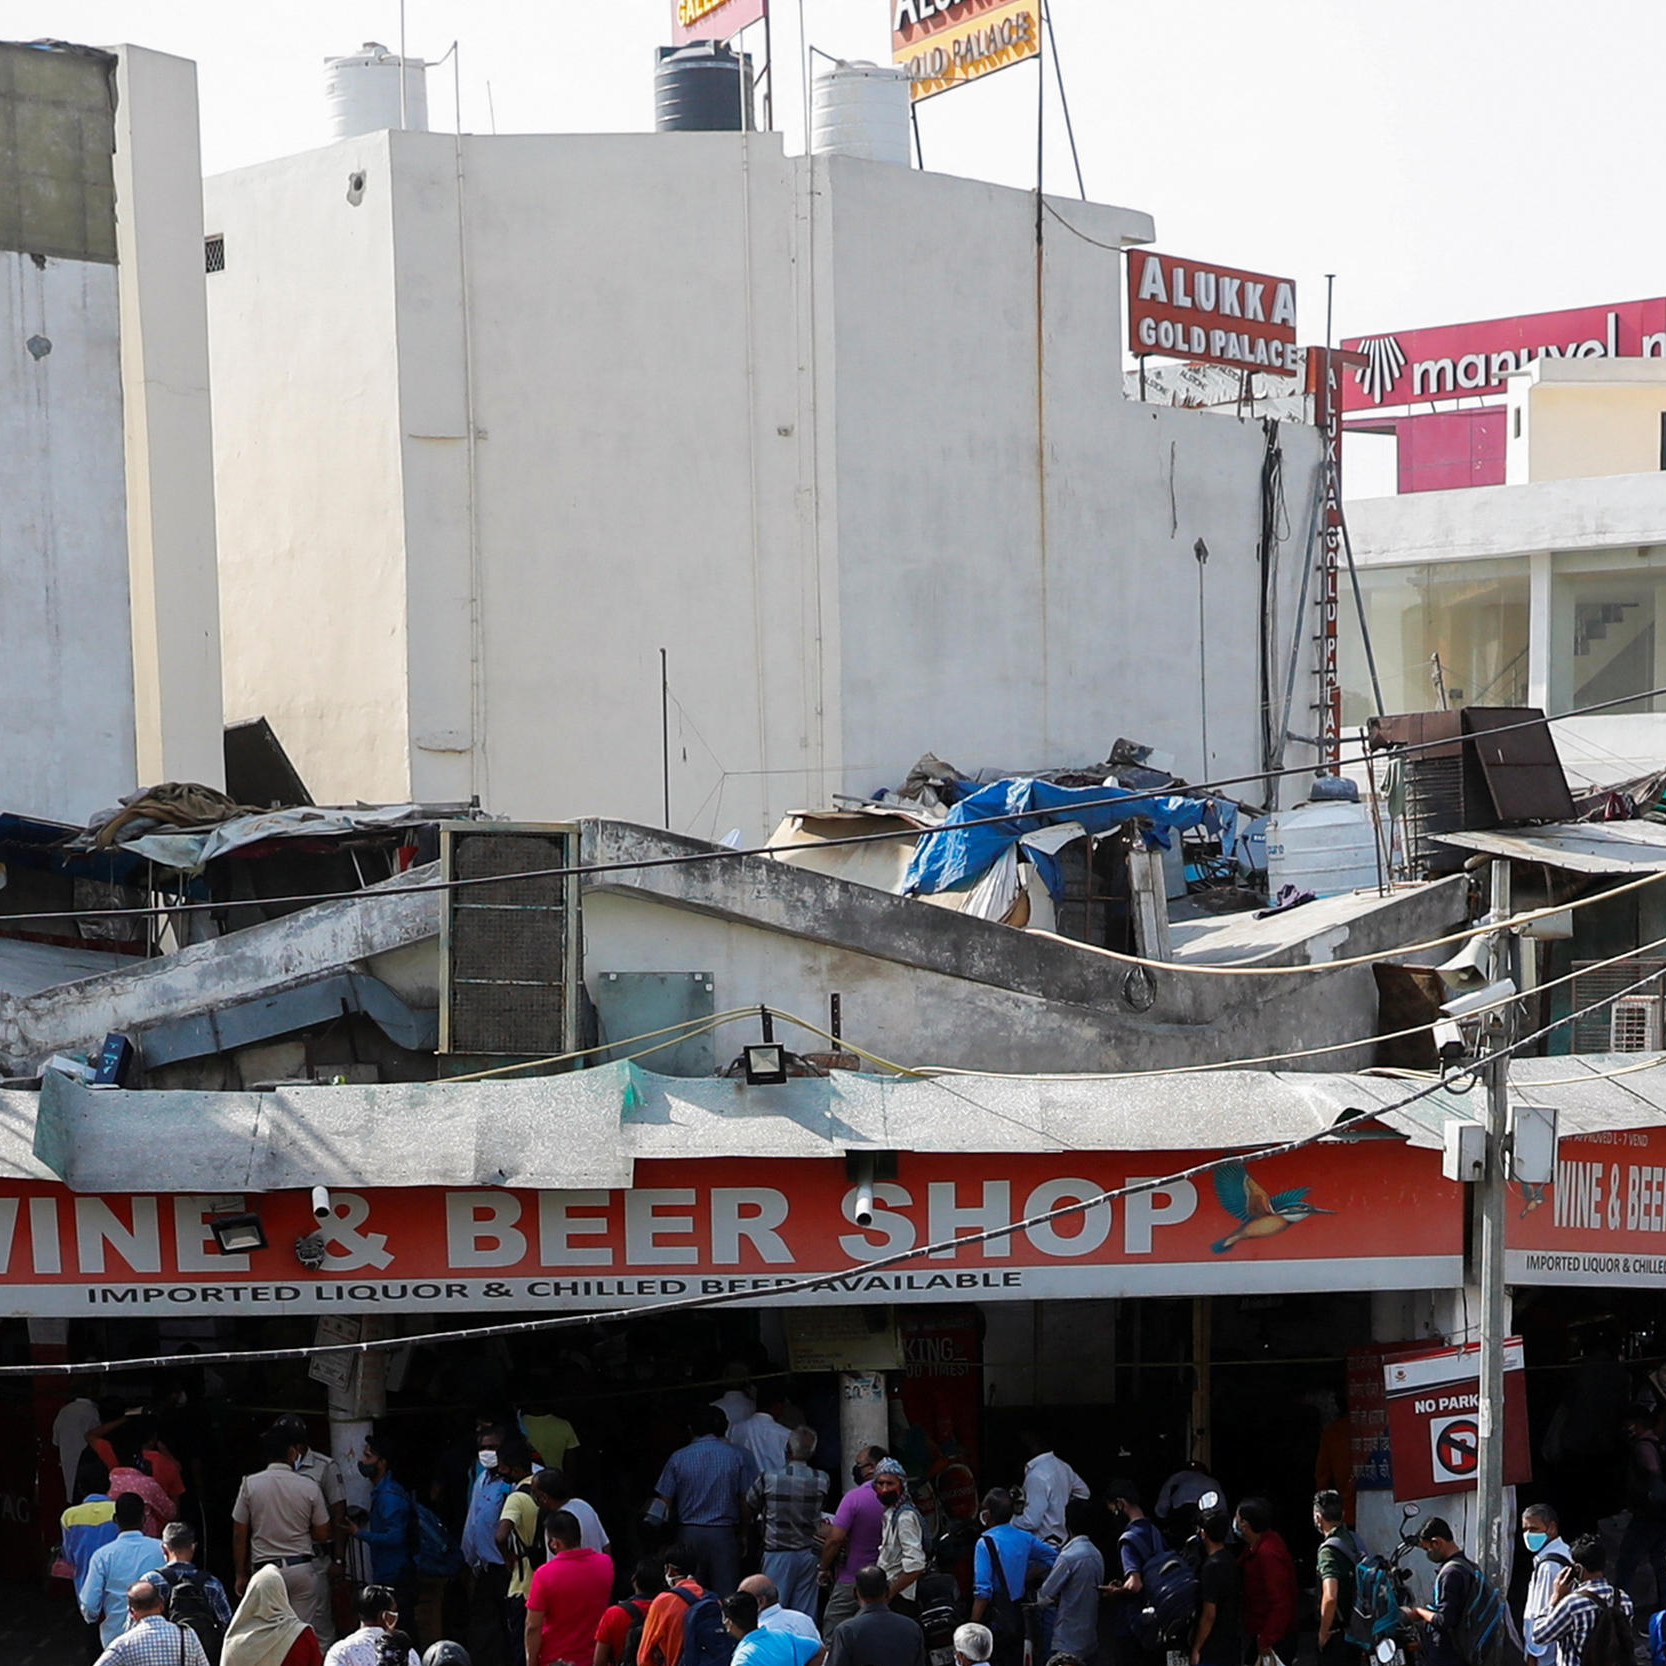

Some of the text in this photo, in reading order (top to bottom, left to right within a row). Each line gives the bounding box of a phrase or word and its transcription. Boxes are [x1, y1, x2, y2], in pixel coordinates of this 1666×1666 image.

[904, 47, 950, 80] OLD
[953, 11, 1031, 67] PALACE
[1139, 255, 1296, 327] ALUKKA
[1139, 317, 1297, 369] GOLD PALACE
[1629, 1134, 1649, 1148] VEND
[1553, 1160, 1604, 1230] WINE
[1608, 1163, 1621, 1231] &
[315, 1192, 396, 1273] &
[446, 1187, 796, 1269] BEER
[839, 1176, 1199, 1265] SHOP
[88, 1284, 302, 1304] IMPORTED
[315, 1281, 469, 1303] LIQUOR
[483, 1280, 513, 1301] &
[525, 1276, 687, 1300] CHILLED
[810, 1270, 1024, 1295] AVAILABLE
[1526, 1255, 1580, 1272] IMPORTED
[1582, 1258, 1621, 1275] LIQUOR
[1623, 1261, 1631, 1274] &
[1415, 1395, 1480, 1415] NO PARK
